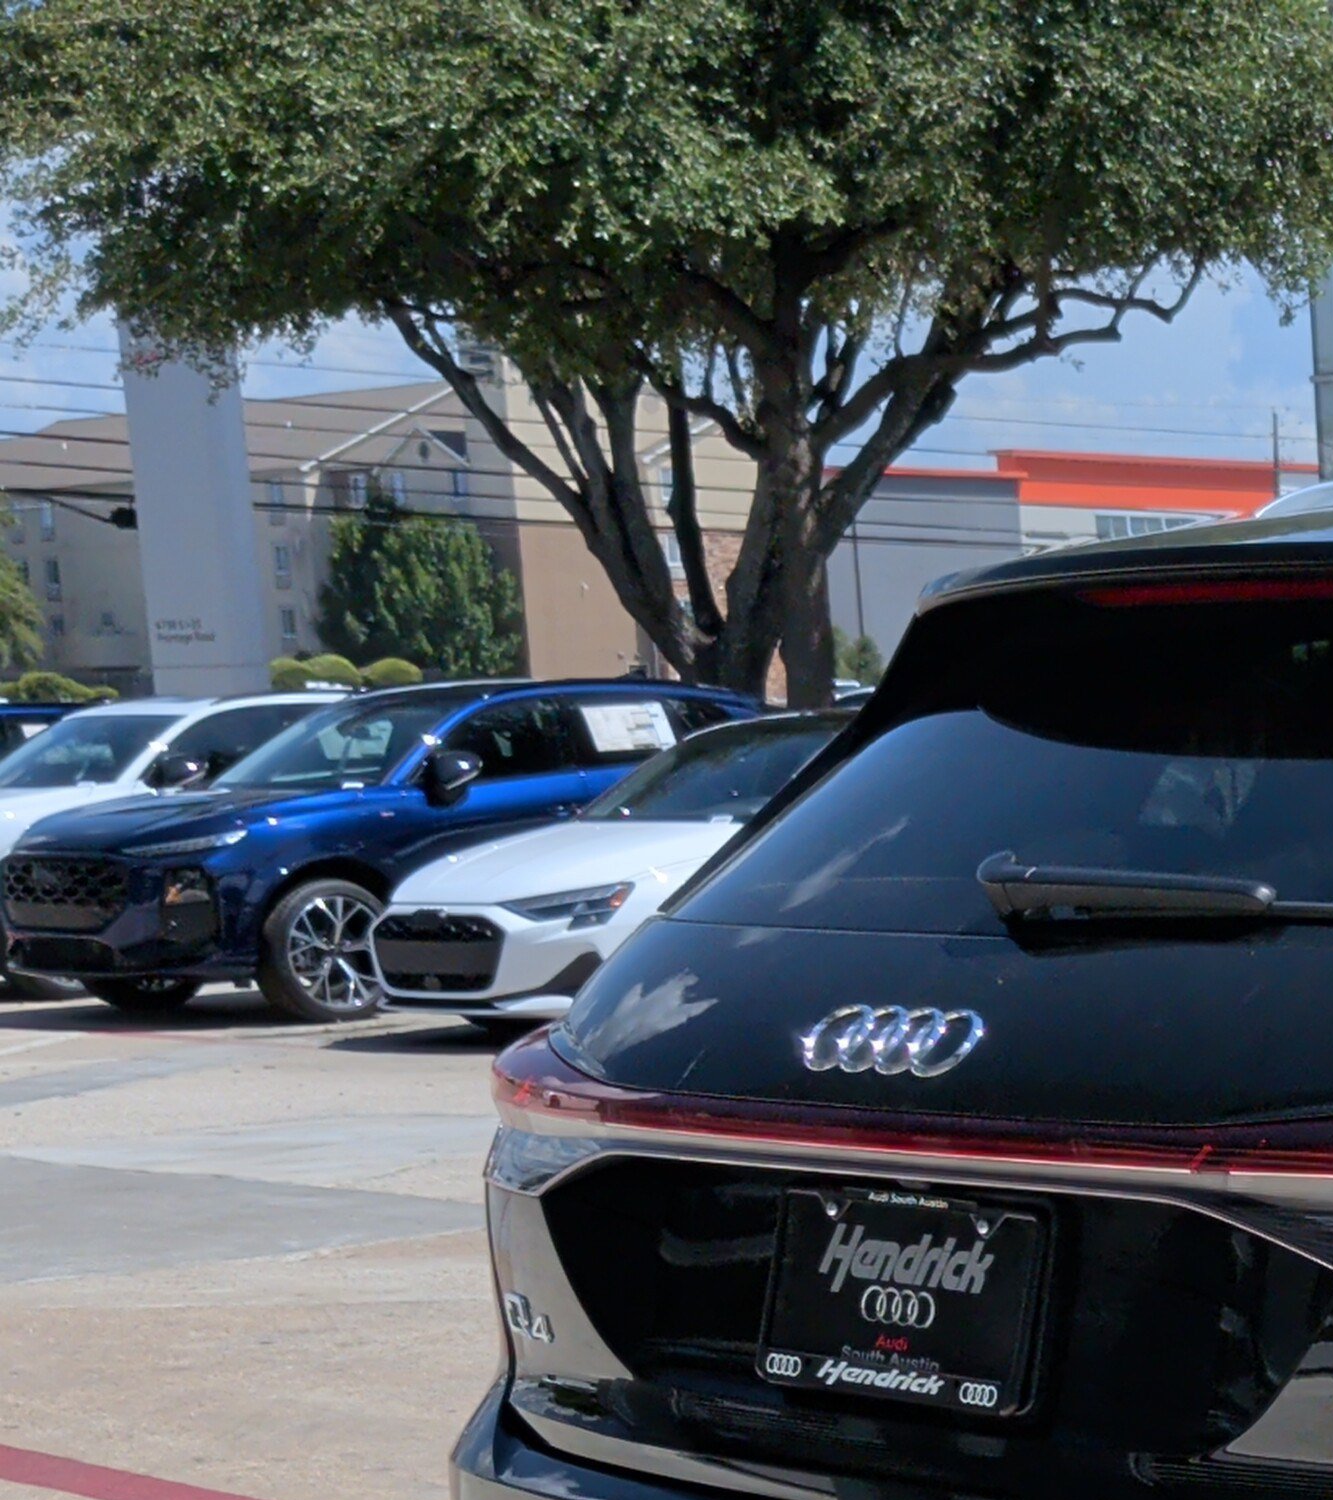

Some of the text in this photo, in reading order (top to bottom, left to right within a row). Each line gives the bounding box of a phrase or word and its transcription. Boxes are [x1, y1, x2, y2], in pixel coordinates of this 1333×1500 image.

[868, 1192, 948, 1209] Audi South Austin
[818, 1223, 994, 1294] Hendrick
[504, 1291, 555, 1343] Q4
[841, 1345, 940, 1371] South Austin
[875, 1334, 908, 1351] Audi
[816, 1359, 945, 1395] Hendrick
